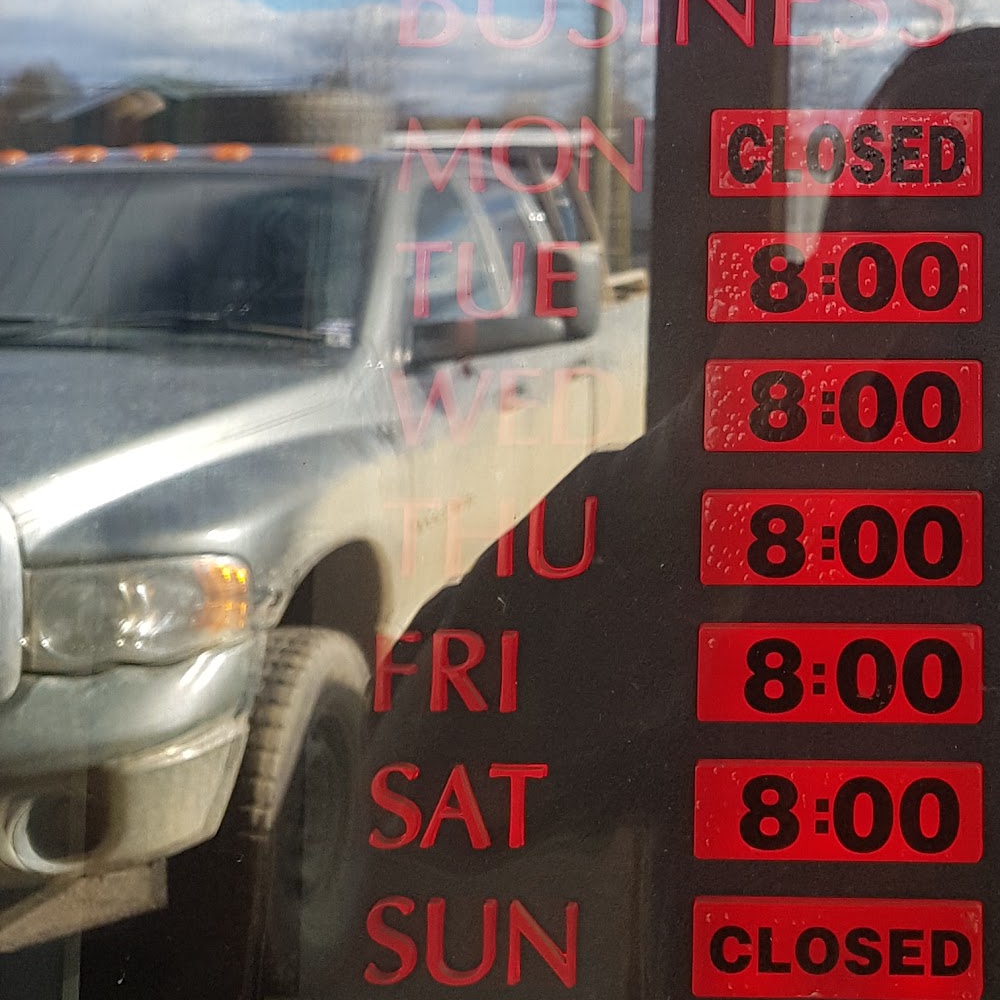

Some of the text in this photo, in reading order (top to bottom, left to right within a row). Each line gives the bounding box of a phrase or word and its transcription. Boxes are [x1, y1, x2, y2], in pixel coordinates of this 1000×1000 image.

[398, 115, 647, 194] MON
[726, 123, 966, 185] CLOSED
[395, 240, 580, 319] TUE
[750, 241, 960, 314] 8:00
[389, 368, 623, 448] WED
[748, 370, 962, 444] 8:00
[383, 495, 598, 580] THU
[746, 504, 963, 580] 8:00
[372, 628, 520, 713] FRI
[743, 638, 963, 715] 8:00
[368, 762, 549, 850] SAT
[738, 774, 964, 854] 8:00
[363, 896, 580, 989] SUN
[709, 925, 972, 977] CLOSED
